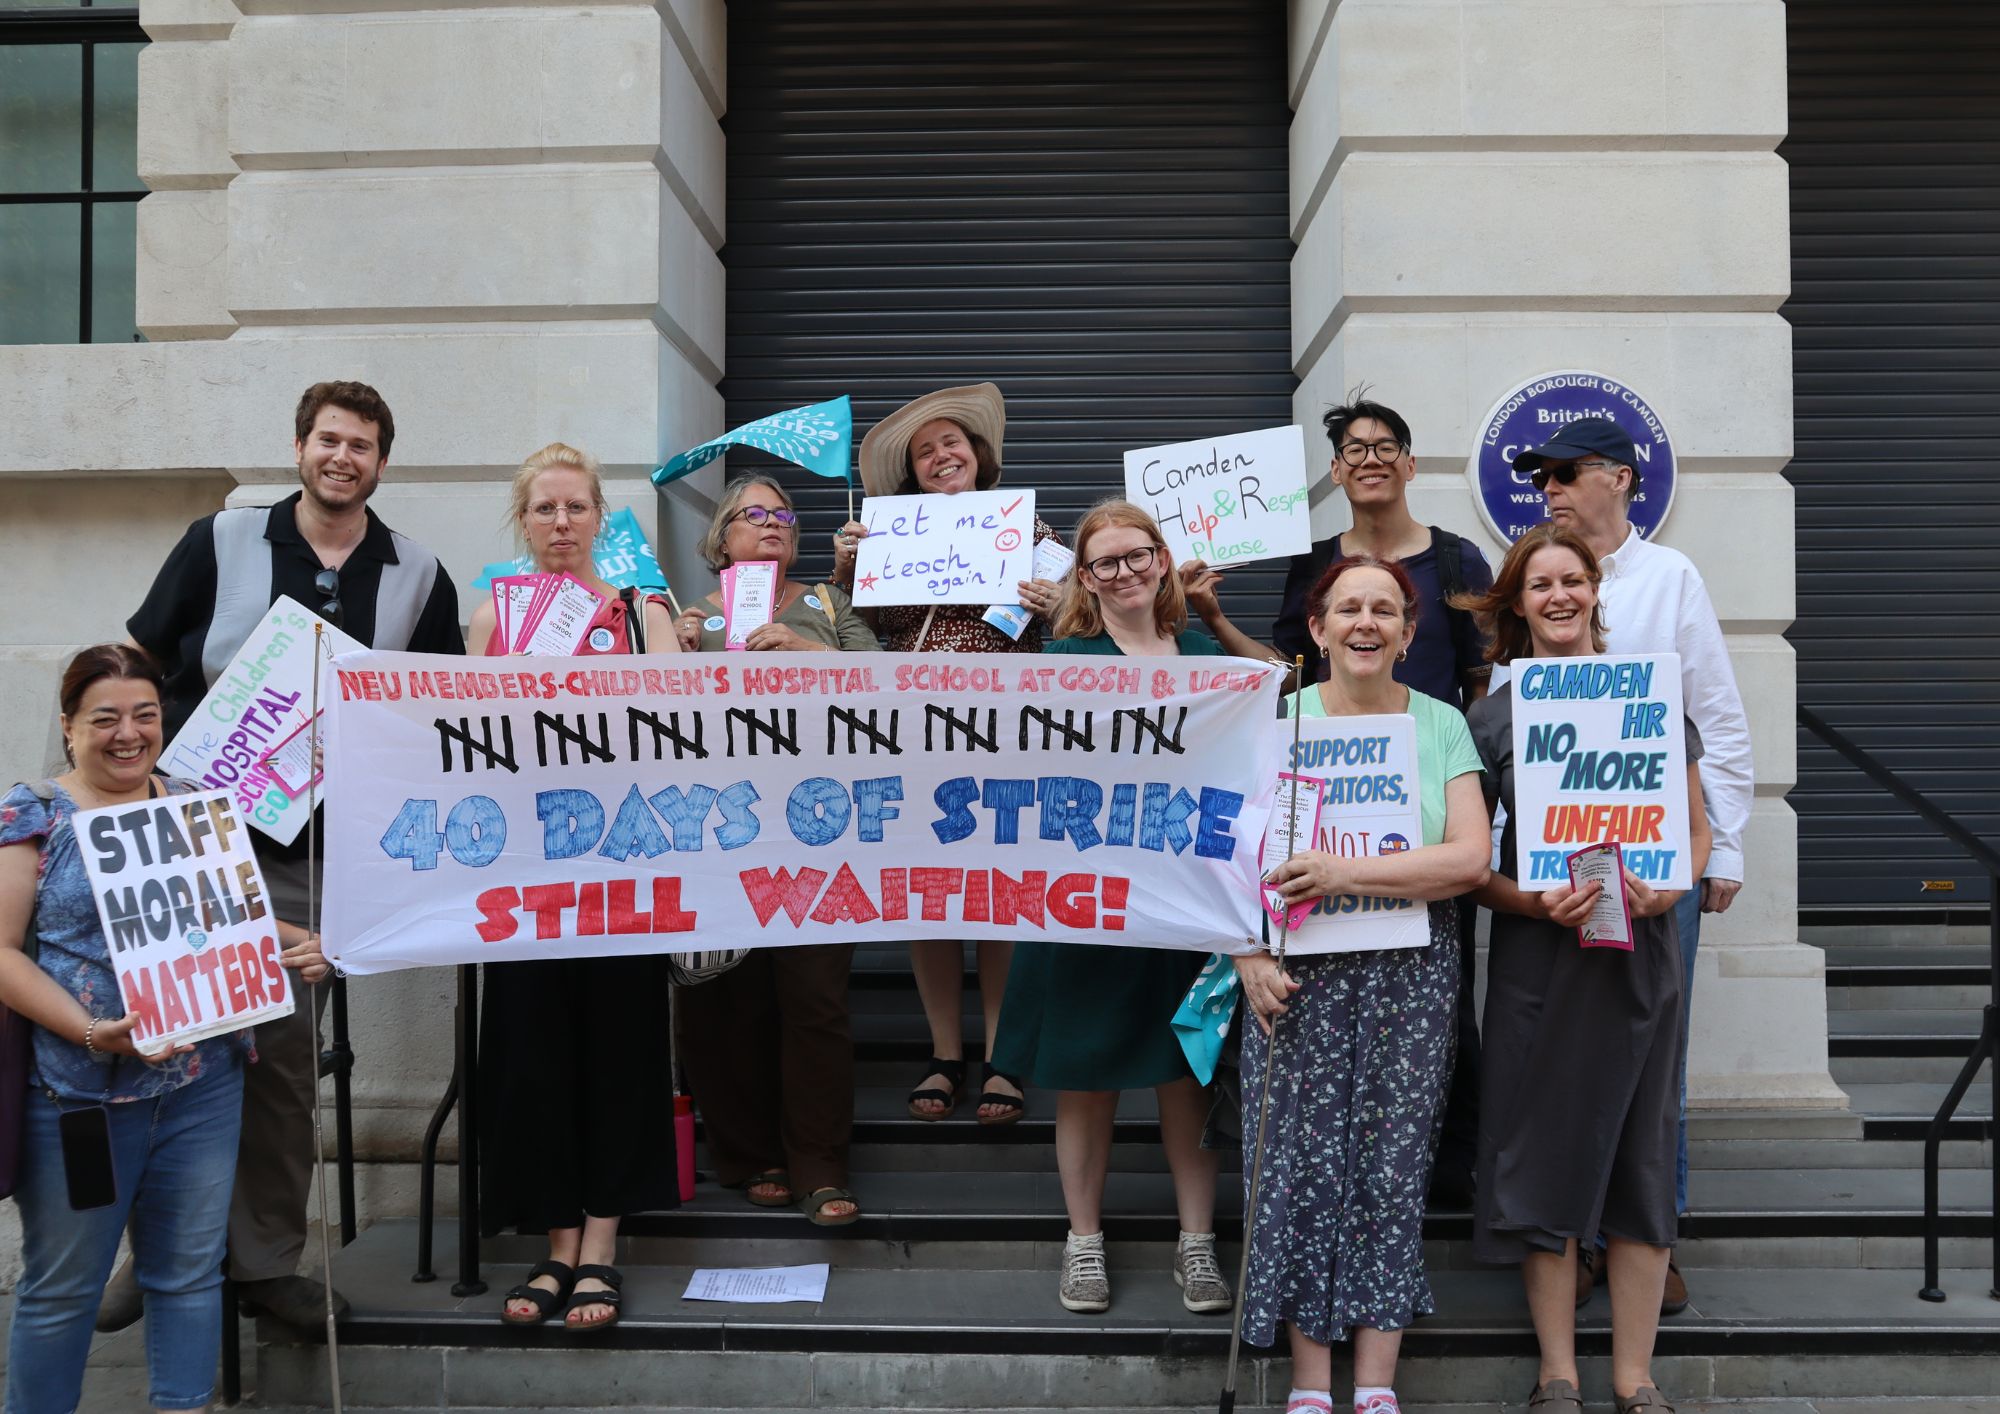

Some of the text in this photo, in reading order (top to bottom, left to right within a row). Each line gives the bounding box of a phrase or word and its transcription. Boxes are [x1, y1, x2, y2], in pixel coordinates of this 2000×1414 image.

[1485, 376, 1666, 446] LONDON BOROUGH OF CAMDEN
[1142, 447, 1255, 496] Camden
[1155, 497, 1220, 542] Help
[1213, 489, 1237, 517] &
[1510, 493, 1543, 504] was
[868, 504, 1000, 538] Let me
[882, 544, 970, 580] teach
[1192, 538, 1268, 561] Please
[549, 620, 573, 638] SCHOOL
[558, 618, 571, 628] OUR
[560, 610, 576, 623] SAVE
[168, 612, 308, 773] The Children's
[337, 669, 400, 700] NEU
[742, 666, 880, 695] HOSPITAL
[895, 664, 1005, 692] SCHOOL
[1018, 668, 1056, 692] AT
[1058, 666, 1142, 694] GOSH
[1151, 669, 1176, 700] &
[1520, 661, 1654, 701] CAMDEN
[200, 687, 302, 790] HOSPITAL
[1621, 702, 1667, 740] HR
[1288, 736, 1391, 769] SUPPORT
[1524, 722, 1577, 764] NO
[235, 745, 273, 814] SCHO
[1560, 751, 1667, 791] MORE
[255, 790, 291, 826] GO
[380, 776, 1244, 870] 40 DAYS OF STRIKE
[1282, 813, 1300, 821] SAE
[1543, 804, 1665, 844] UNFAIR
[89, 797, 237, 873] STAFF
[1274, 829, 1304, 838] SCHOL
[1321, 826, 1370, 858] NOT
[103, 860, 266, 953] MORALE
[475, 861, 1130, 942] STILL WAITING!
[121, 935, 285, 1041] MATTERS
